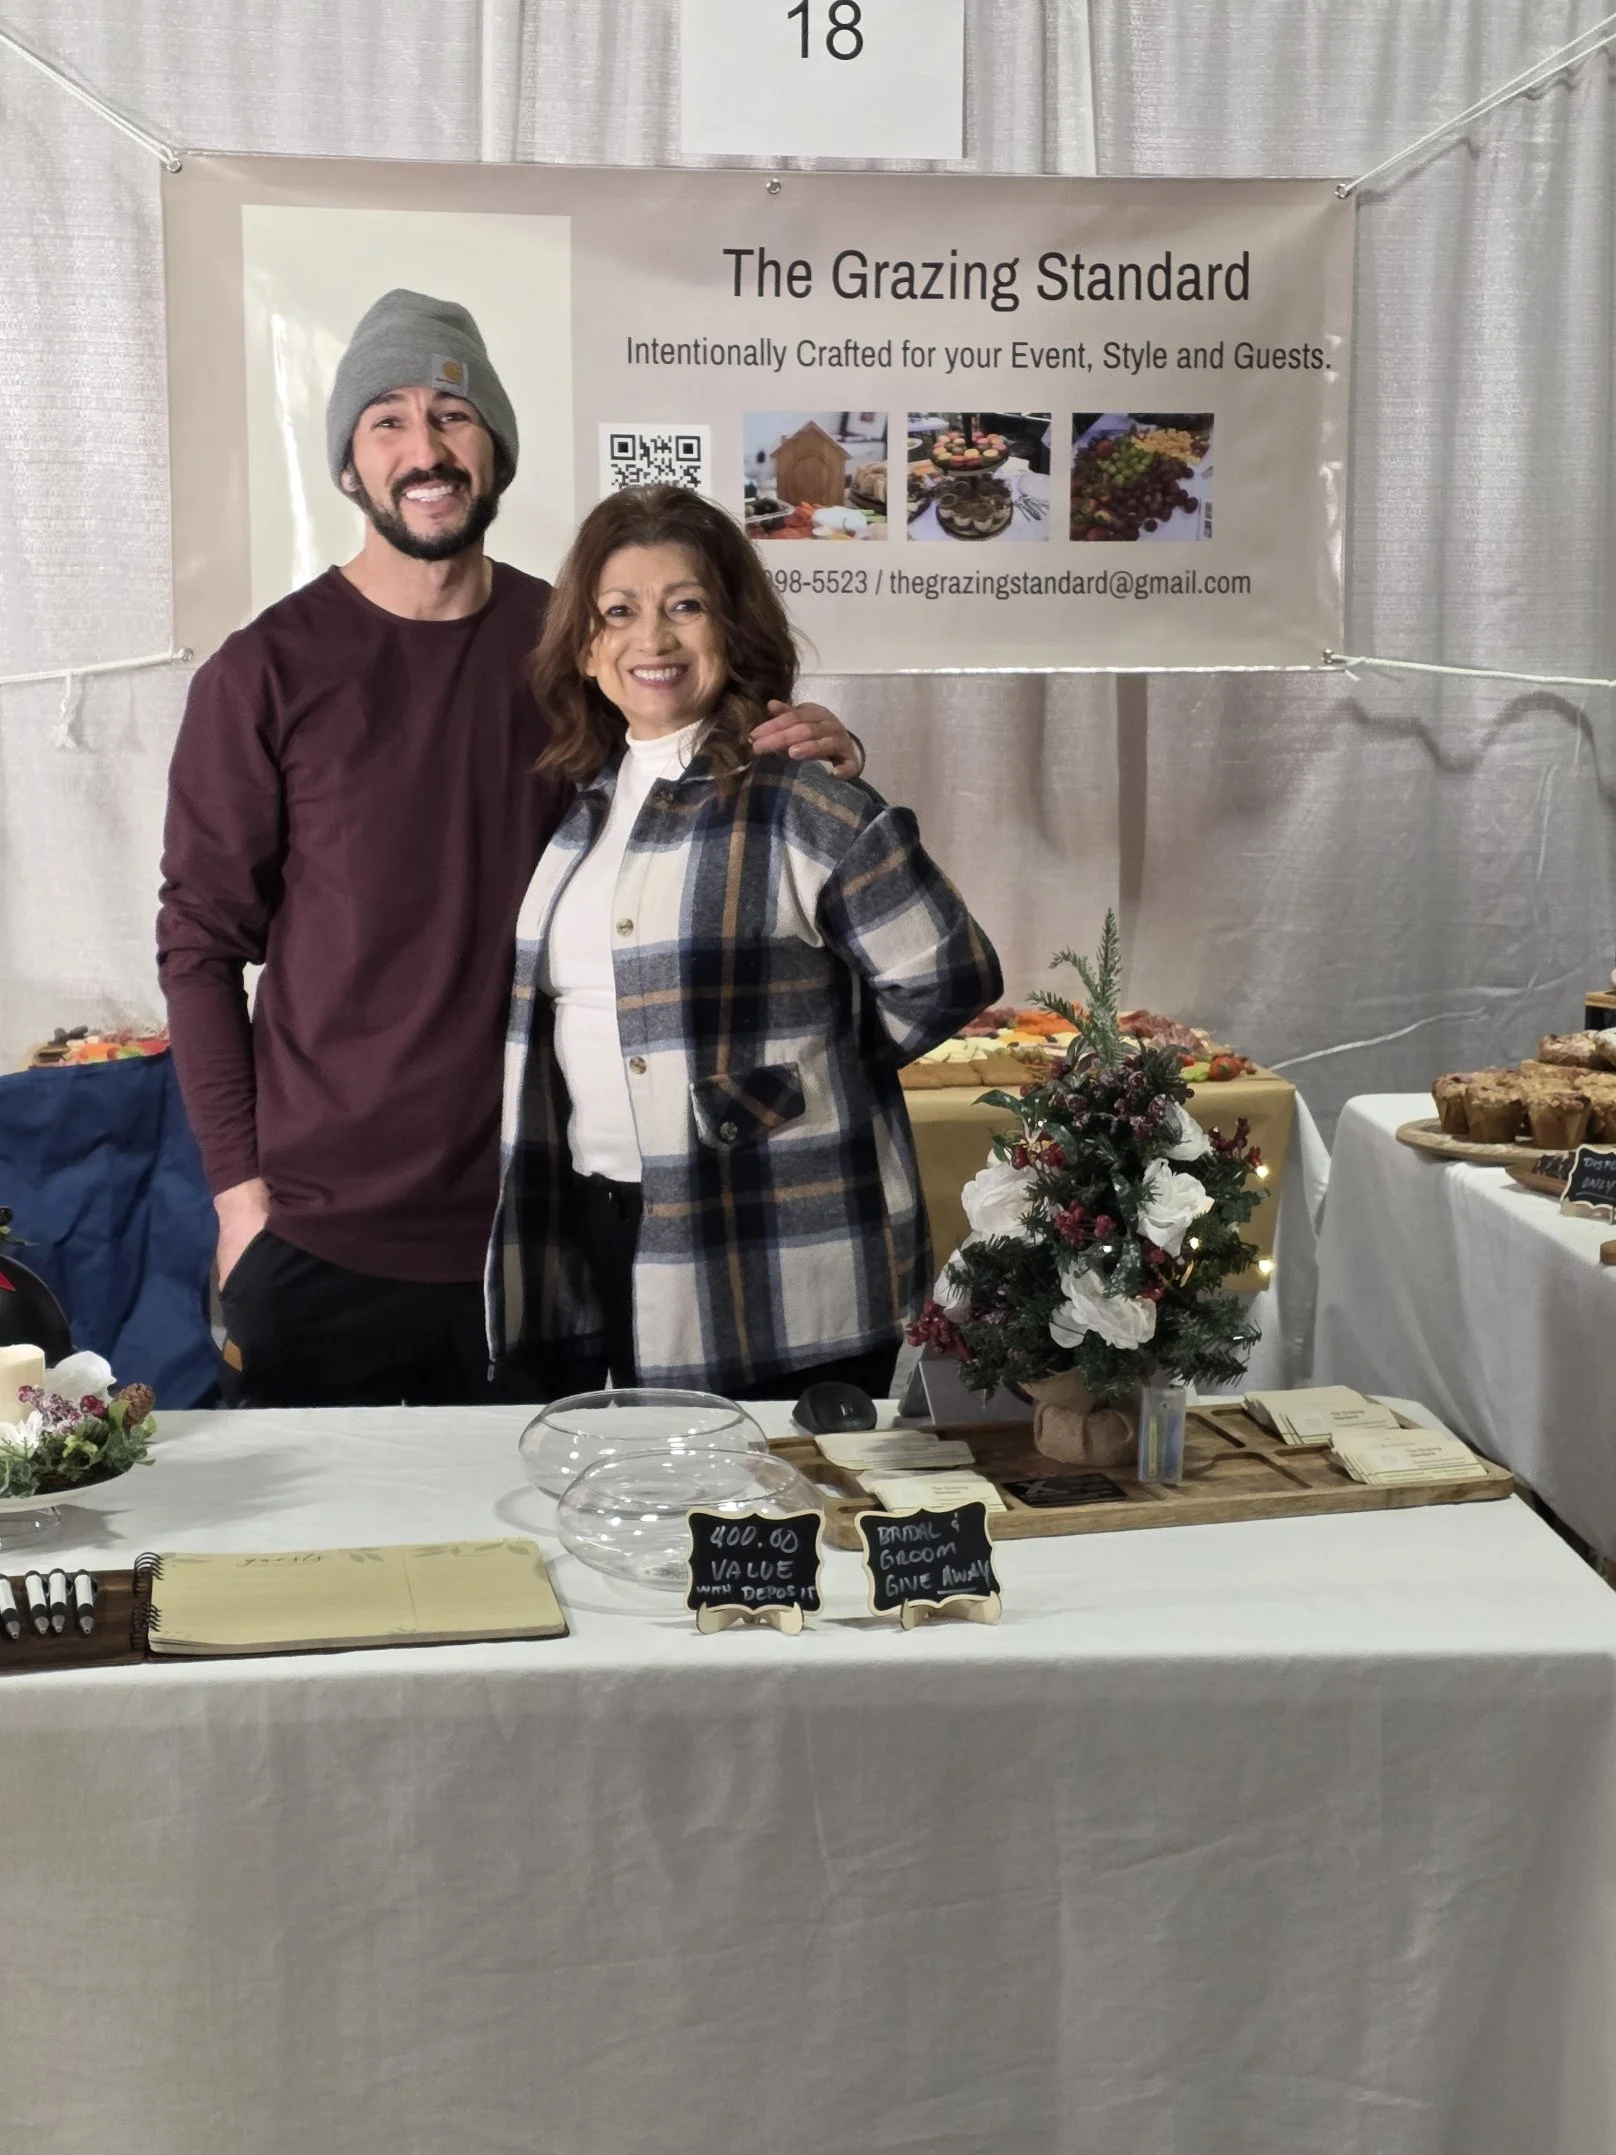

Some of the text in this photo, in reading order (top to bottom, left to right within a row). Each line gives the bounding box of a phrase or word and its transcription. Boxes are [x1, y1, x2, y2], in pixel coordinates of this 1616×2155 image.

[787, 0, 864, 61] 18
[723, 247, 1251, 312] The Grazing Standard
[626, 336, 1332, 375] Intentionally Crafted for your Event, Style and Guests.
[889, 569, 1252, 601] thegrazingstandard@gmail.com
[709, 1525, 798, 1554] 400.00
[877, 1521, 941, 1546] BRIDAL
[711, 1558, 795, 1581] VALUE
[880, 1541, 957, 1570] GROOM
[741, 1584, 816, 1601] DEPOSIT
[885, 1572, 932, 1597] GIVE
